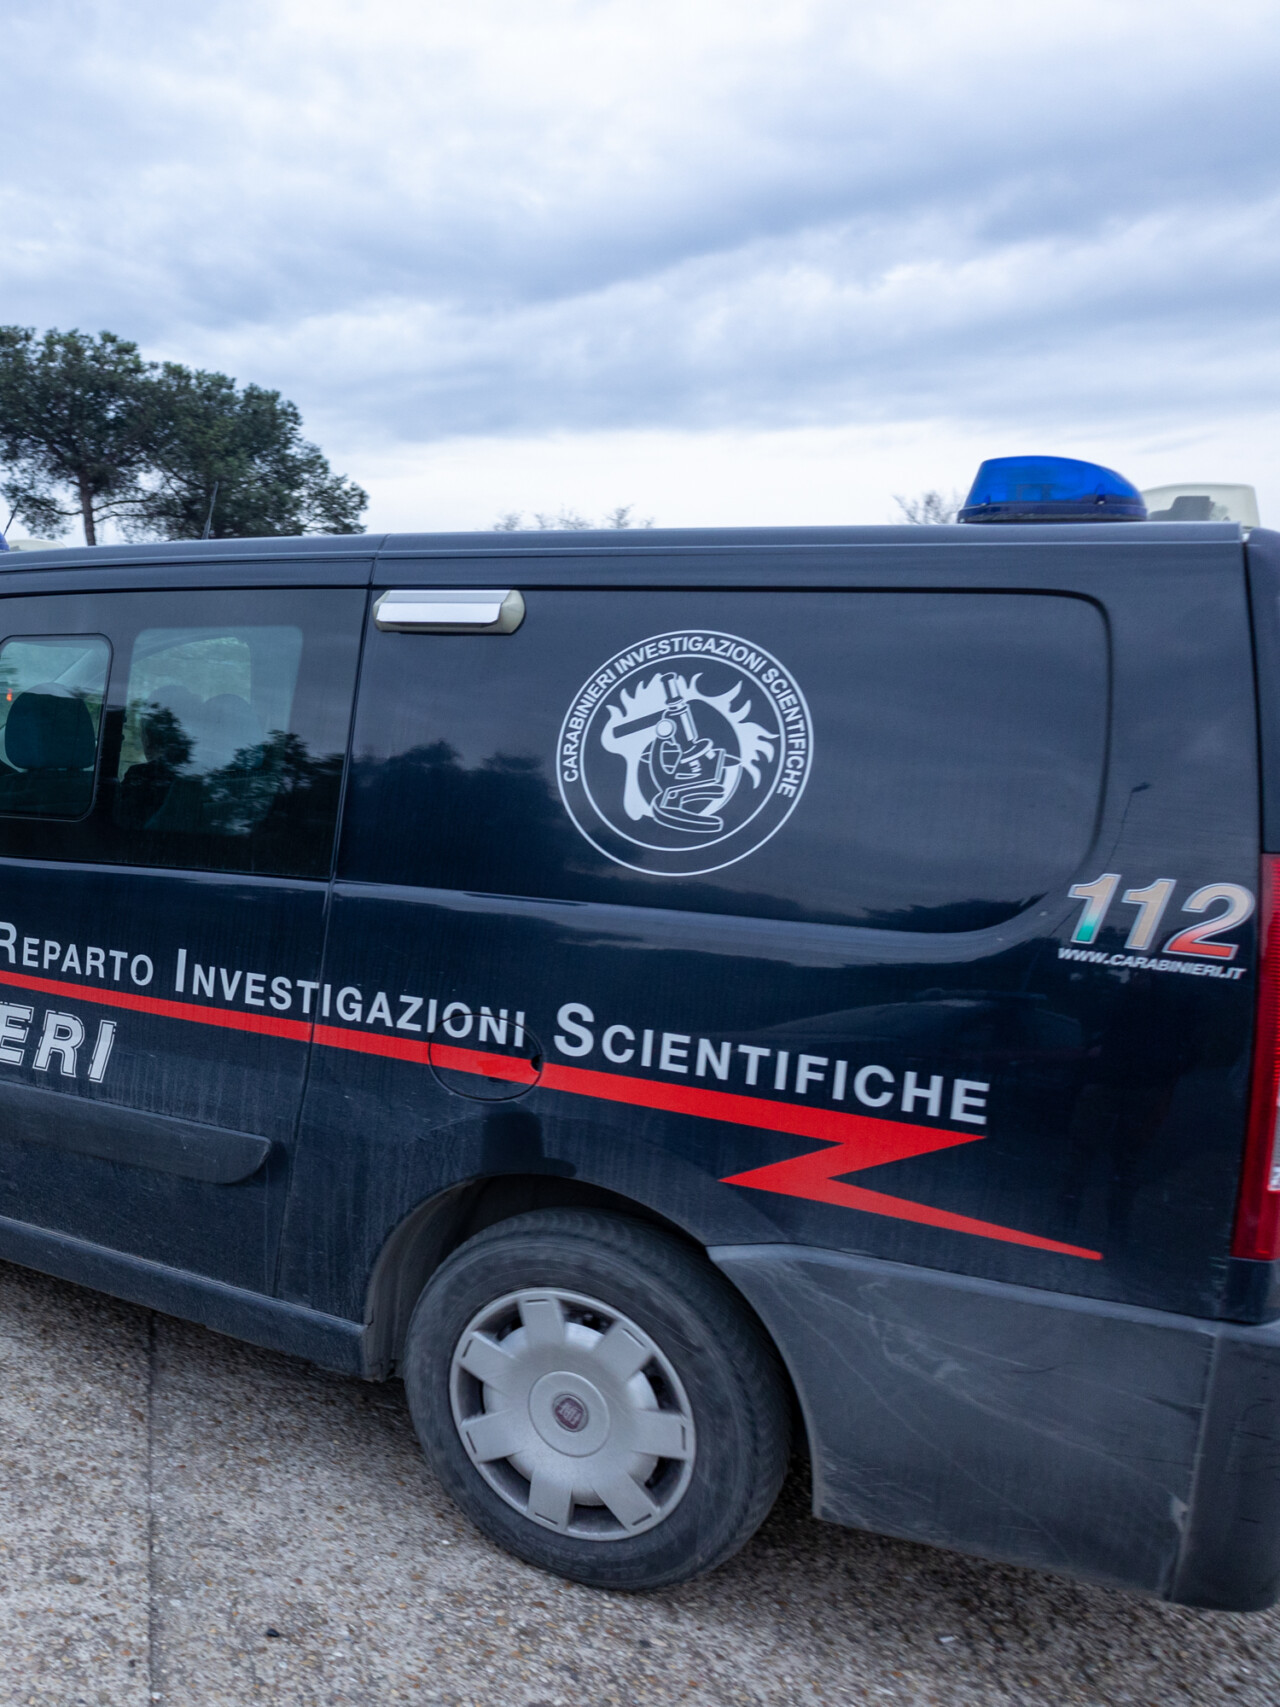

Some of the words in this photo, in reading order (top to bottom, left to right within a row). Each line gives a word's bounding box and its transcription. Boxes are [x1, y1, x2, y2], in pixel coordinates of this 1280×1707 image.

[562, 669, 618, 783] CARABINIERI
[615, 635, 767, 675] INVESTIGAZIONI
[761, 667, 808, 799] SCIENTIFICHE
[1067, 873, 1256, 961] 112
[1057, 947, 1248, 980] WWW.CARABINIERI.IT
